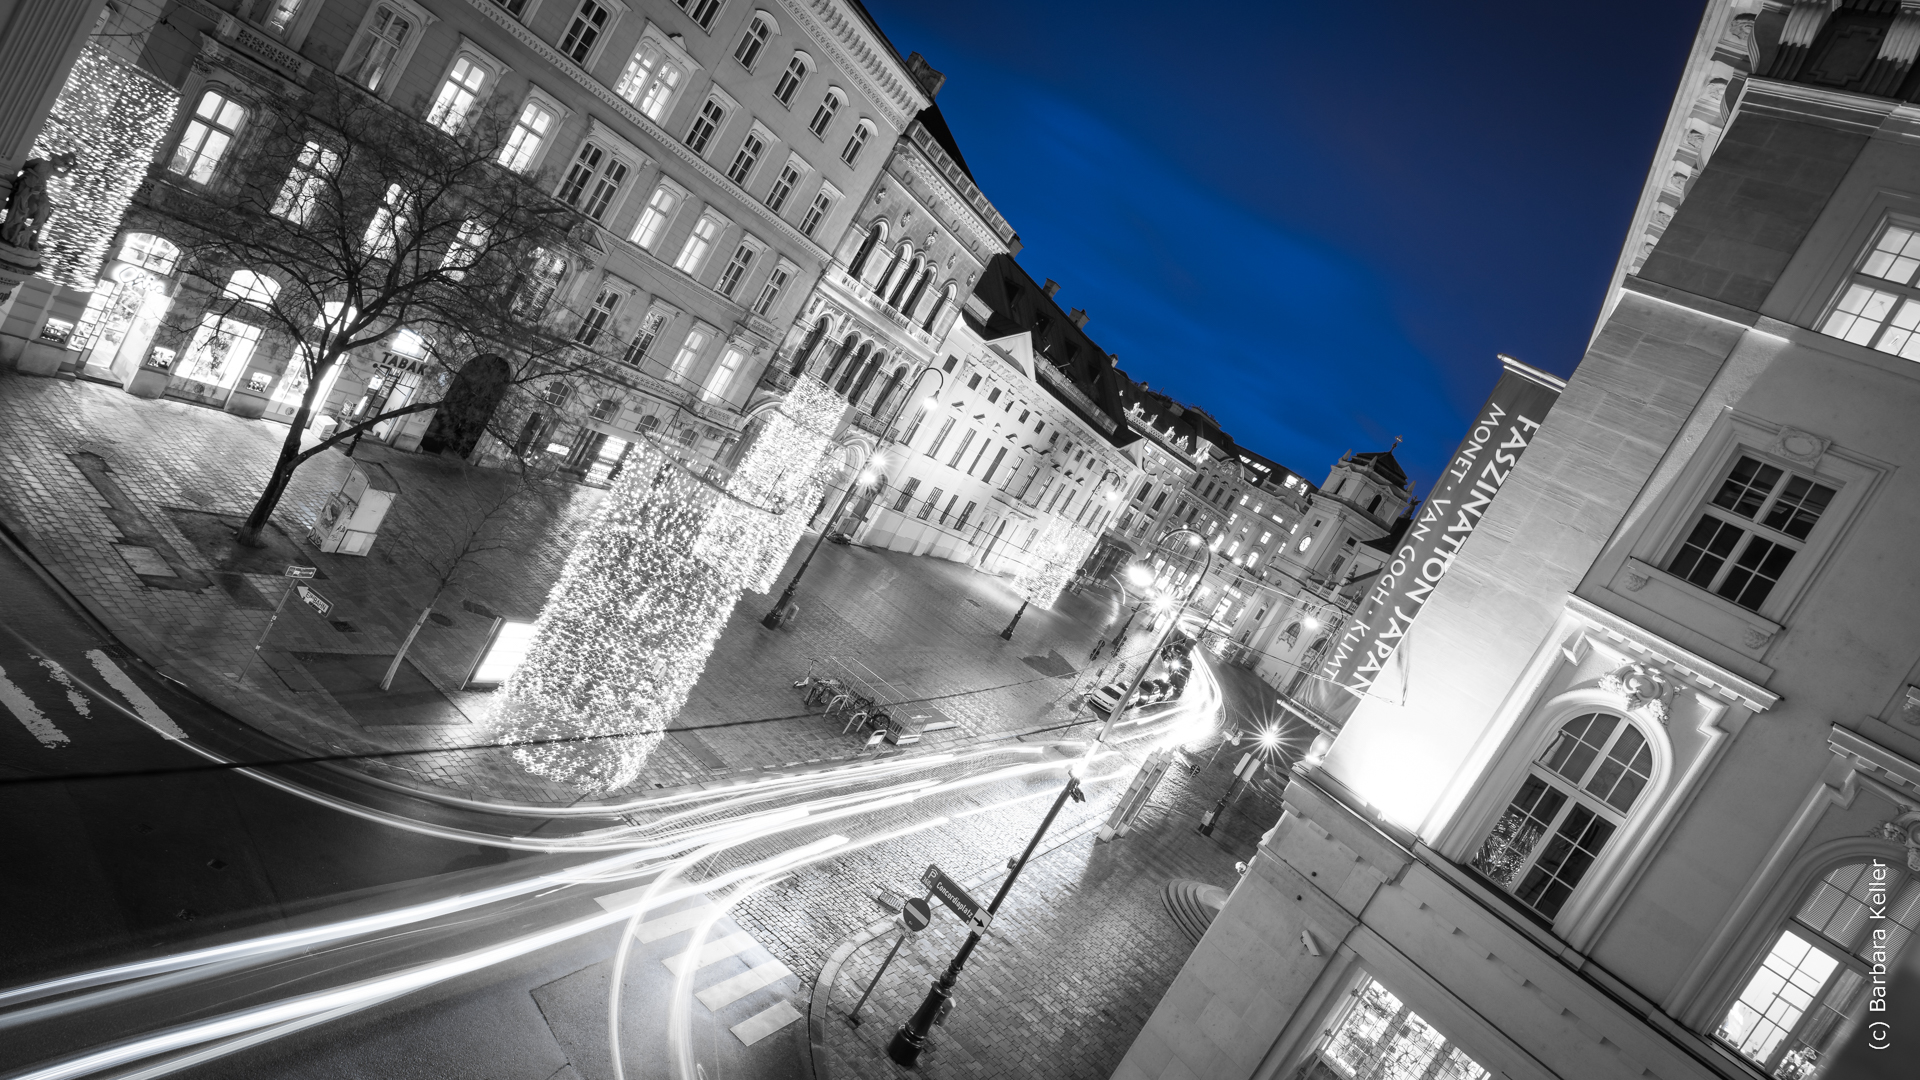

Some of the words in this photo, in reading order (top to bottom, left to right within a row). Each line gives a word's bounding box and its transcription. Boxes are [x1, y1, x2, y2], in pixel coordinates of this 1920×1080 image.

[382, 351, 429, 376] TABAK
[1450, 402, 1507, 484] MONET
[1404, 414, 1541, 605] FASZINATION
[1411, 498, 1452, 542] VAN
[1370, 545, 1416, 606] GOGH
[1322, 619, 1372, 681] KLIMT
[1343, 605, 1414, 700] JAPAN
[936, 881, 974, 919] Concordiaplatz
